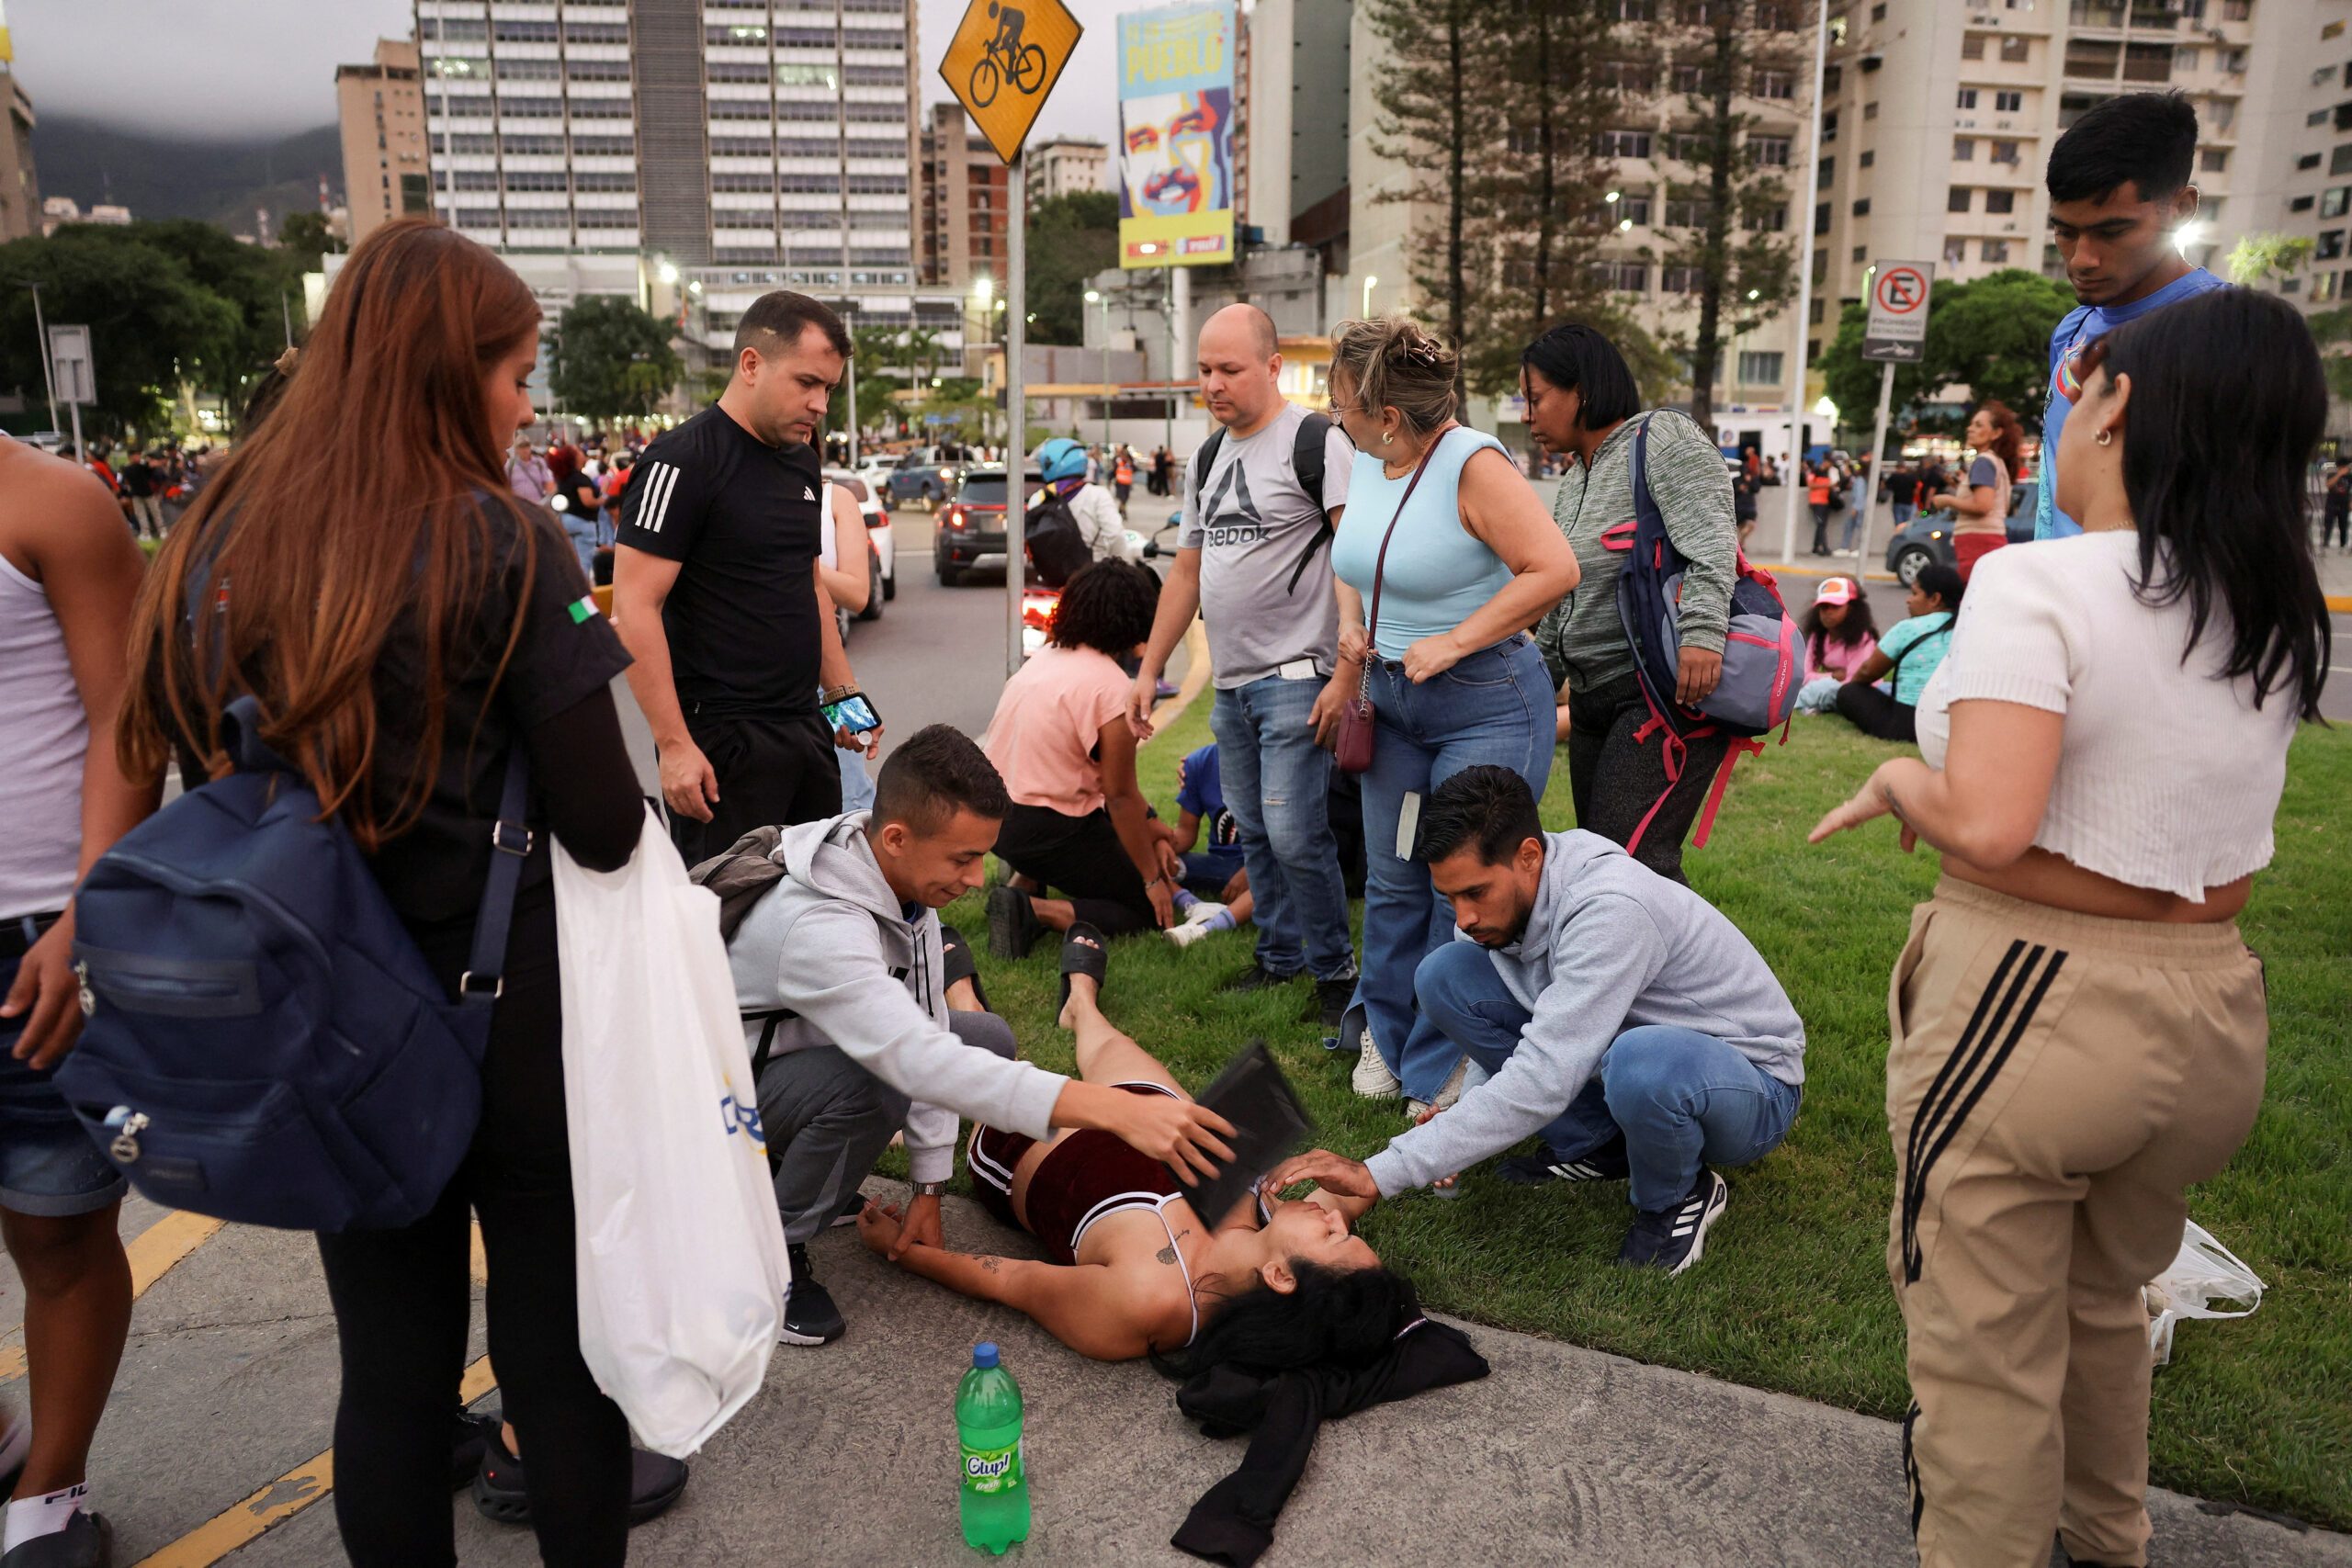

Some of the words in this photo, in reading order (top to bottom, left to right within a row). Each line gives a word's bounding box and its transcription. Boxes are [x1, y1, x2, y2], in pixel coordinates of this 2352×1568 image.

[1126, 32, 1223, 86] PUEBLO
[1776, 660, 1788, 697] Quechua
[967, 1453, 1009, 1476] Glup!
